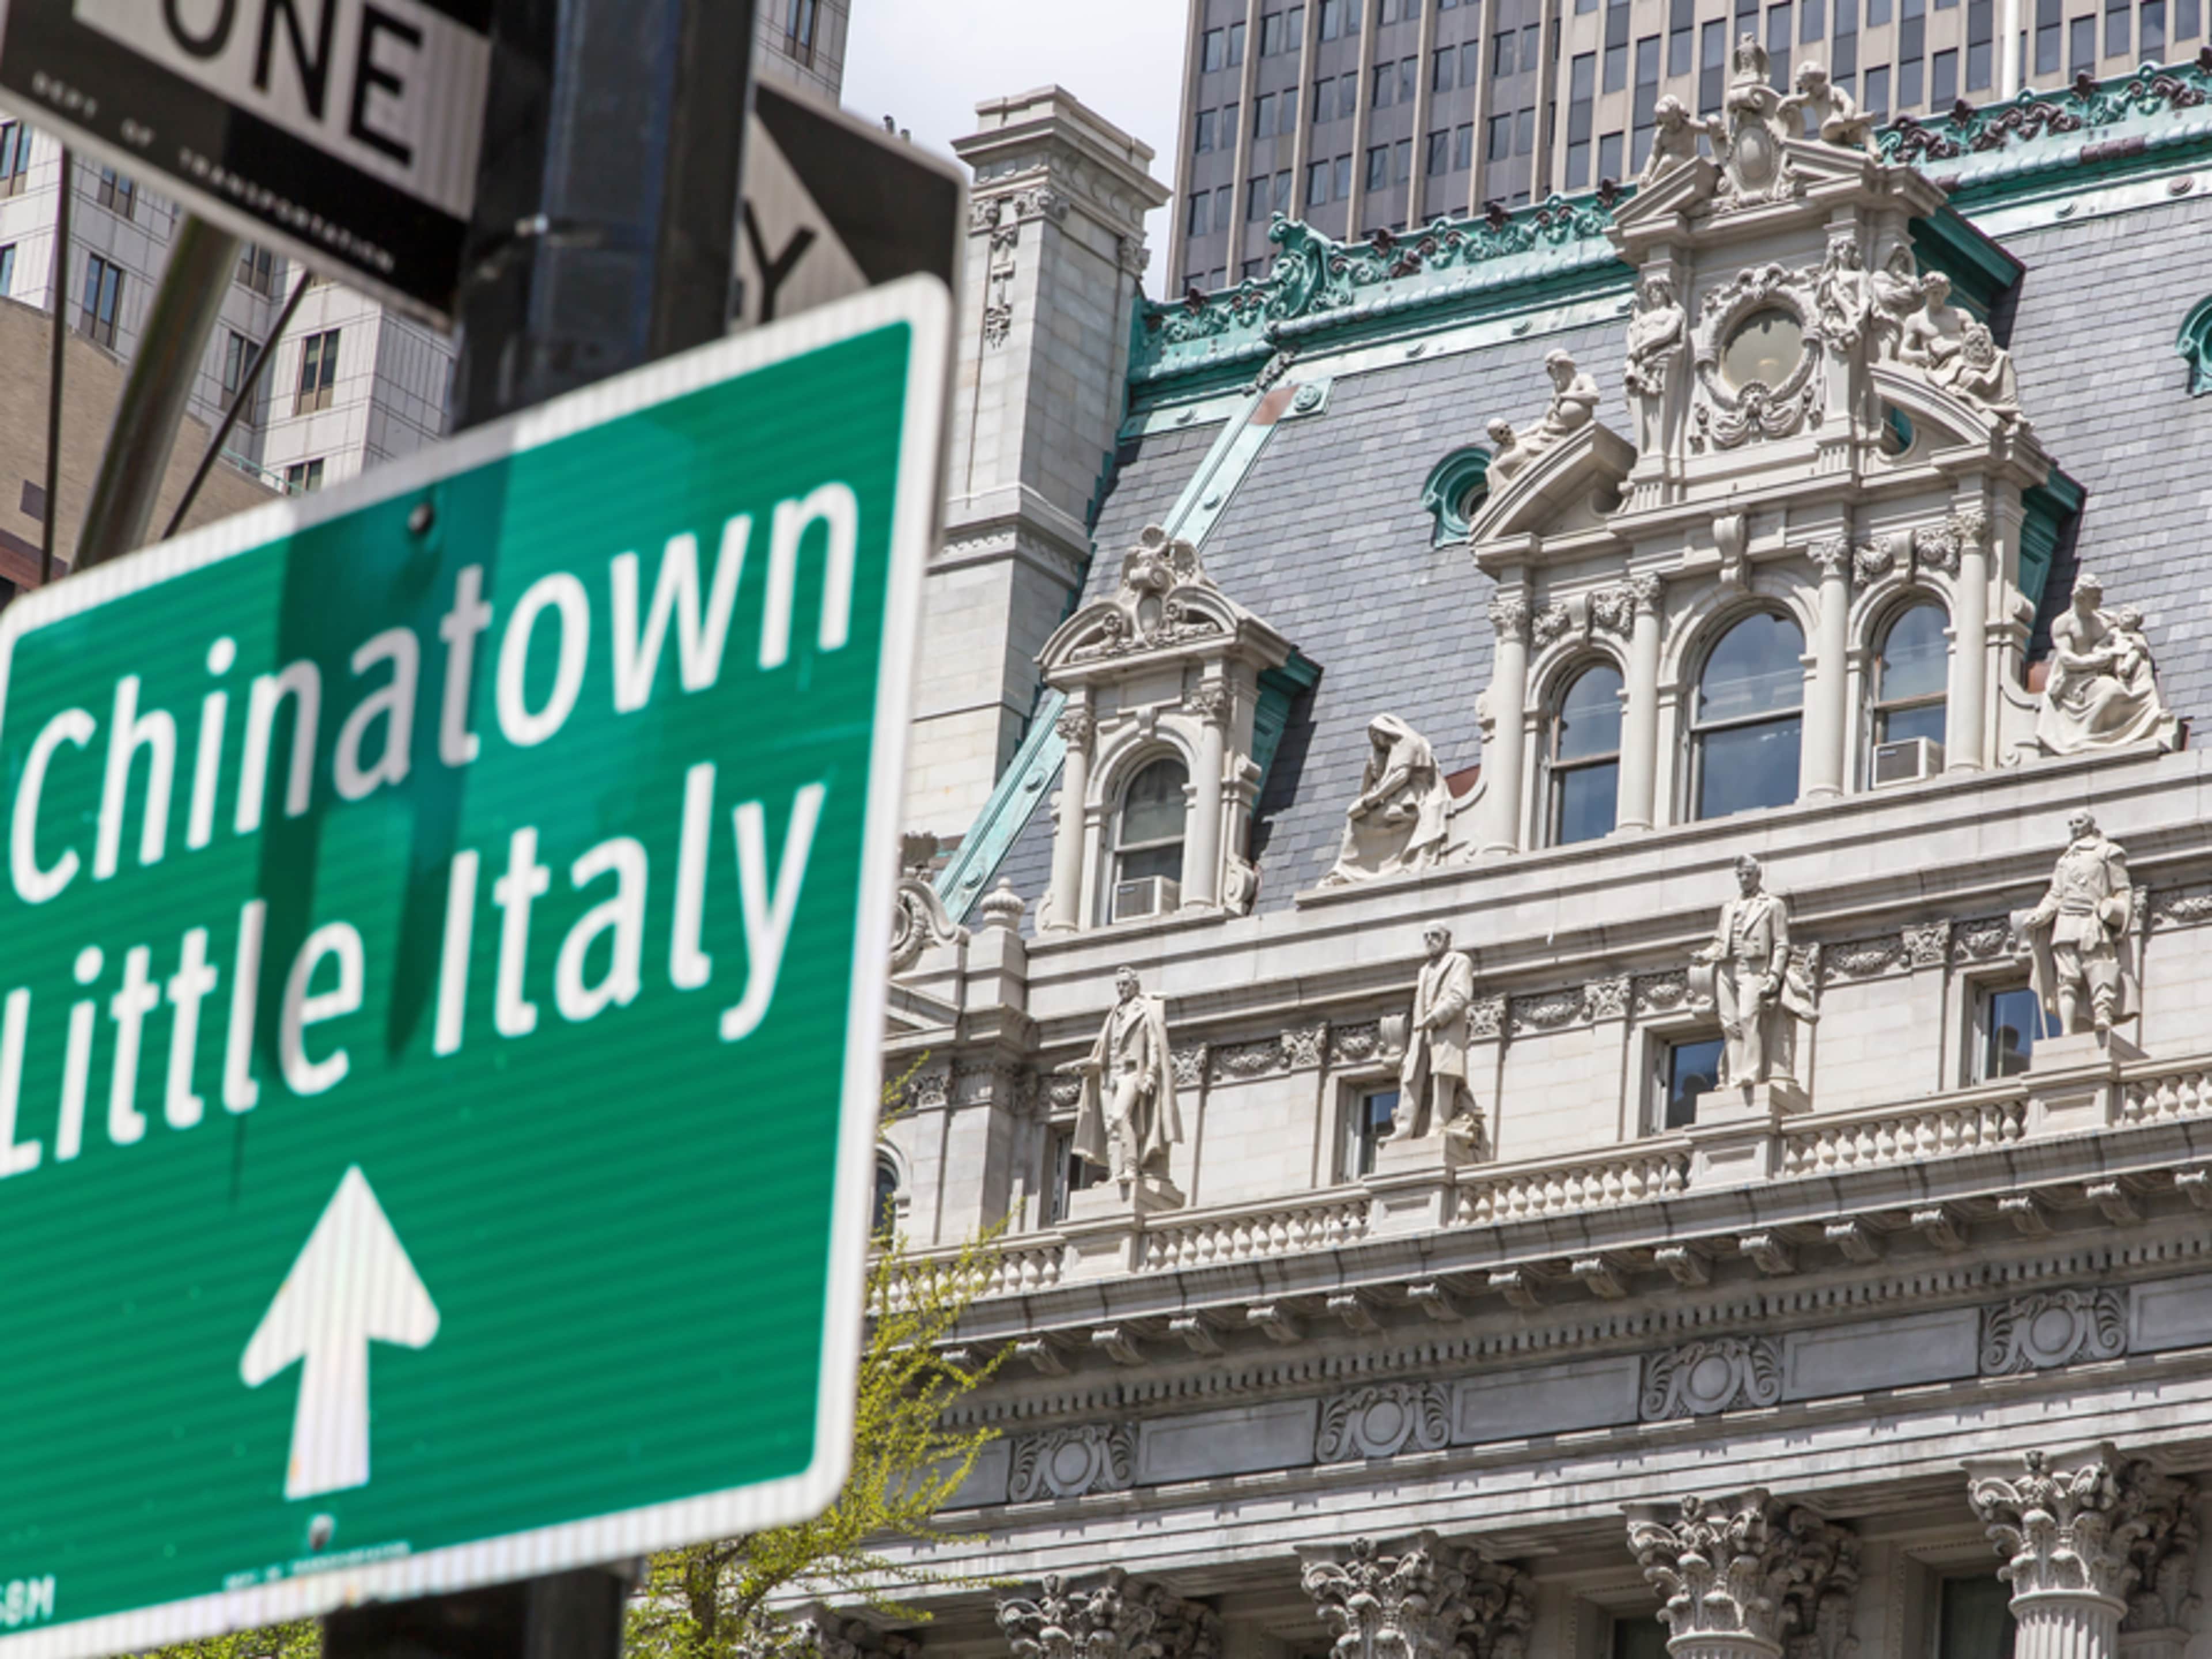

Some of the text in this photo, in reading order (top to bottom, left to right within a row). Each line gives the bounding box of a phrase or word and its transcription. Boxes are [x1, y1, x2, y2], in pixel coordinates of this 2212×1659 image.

[10, 481, 859, 904] Chinatown
[0, 762, 826, 1178] Little Italy
